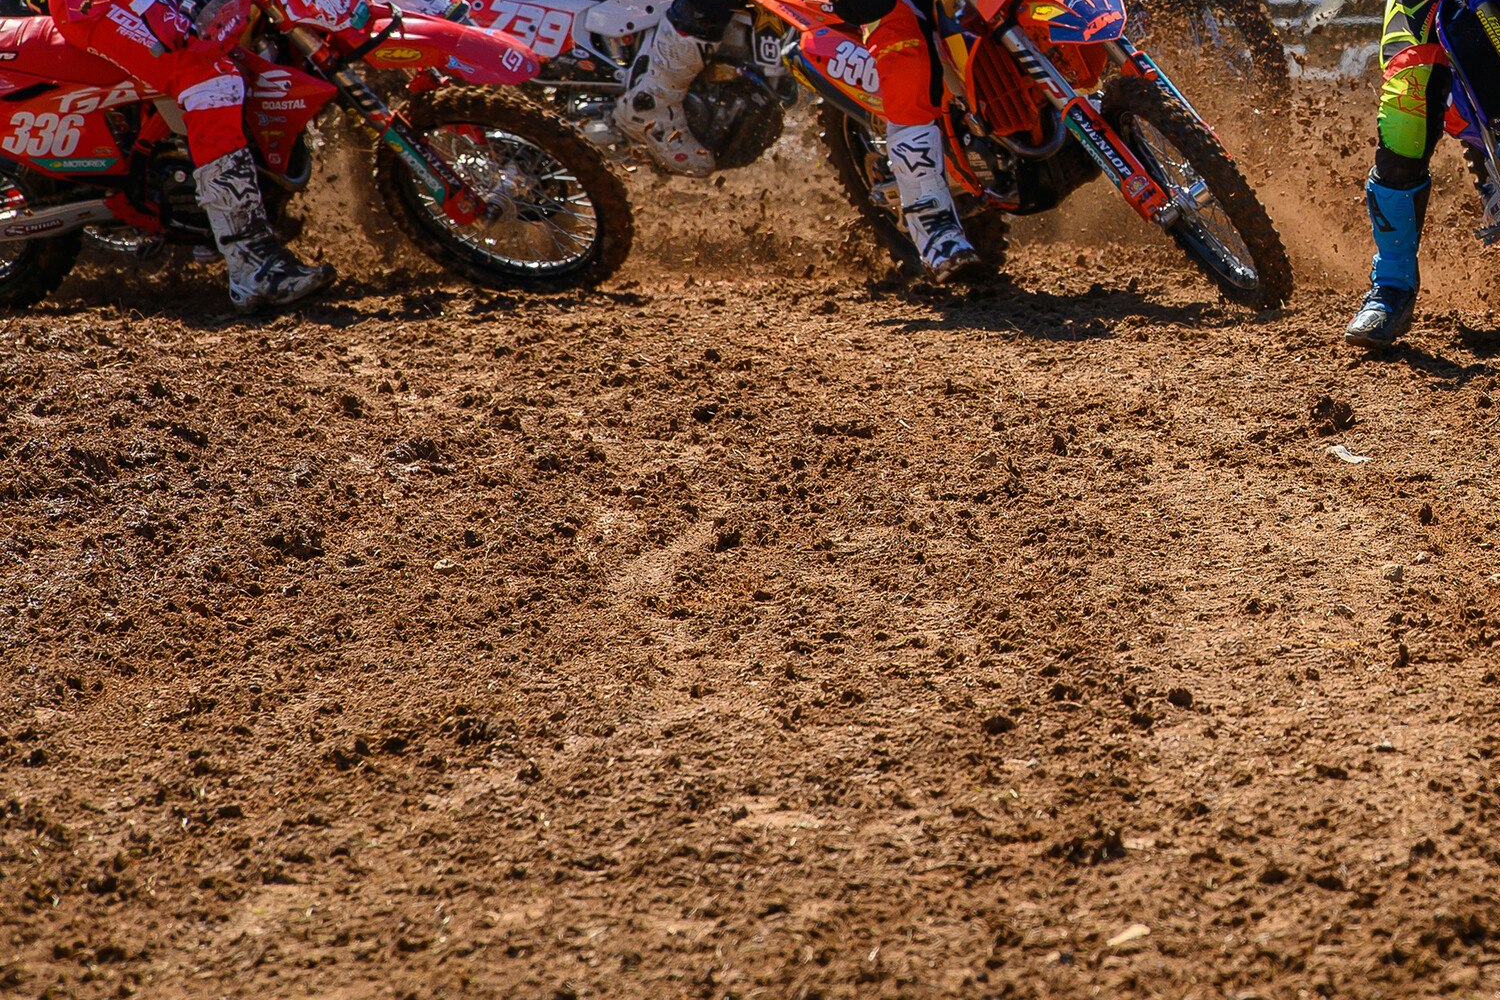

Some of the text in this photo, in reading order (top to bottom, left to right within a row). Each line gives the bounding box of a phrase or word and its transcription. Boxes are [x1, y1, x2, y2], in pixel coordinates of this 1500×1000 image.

[1082, 10, 1123, 42] KTM
[826, 40, 880, 93] 356
[261, 99, 307, 110] COASTAL
[1, 110, 85, 158] 336
[1081, 118, 1133, 177] DUNLOP
[61, 158, 107, 170] MOTOREX
[401, 149, 443, 194] MOTOREX
